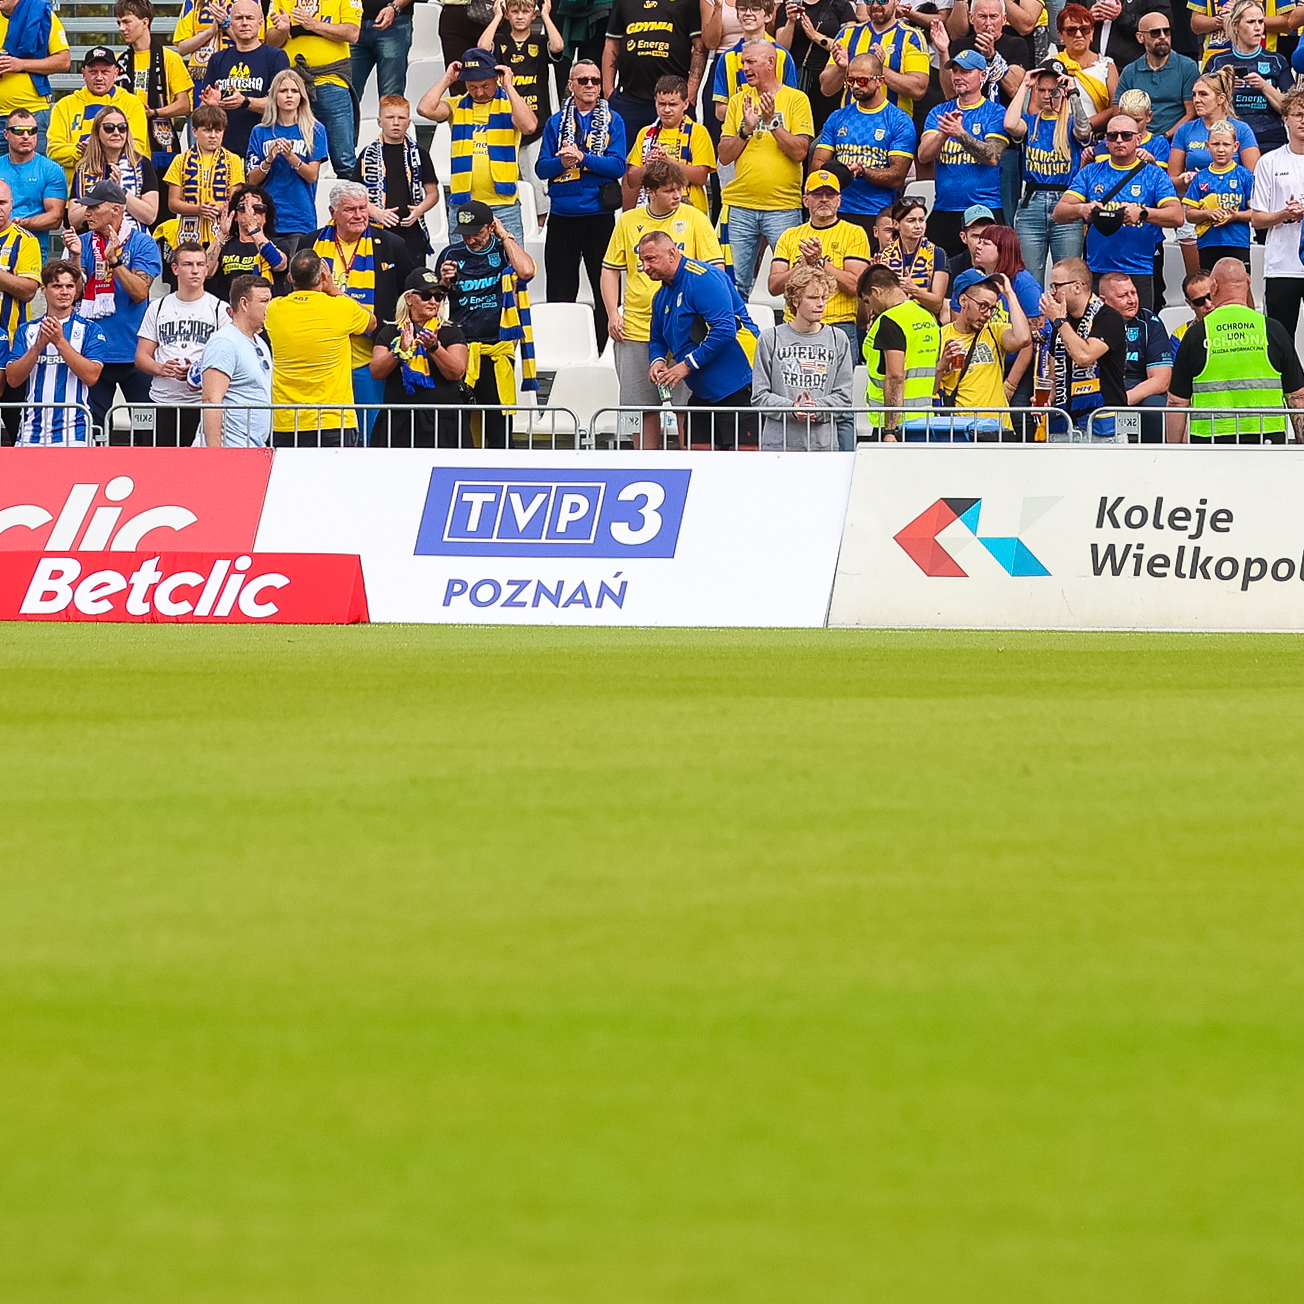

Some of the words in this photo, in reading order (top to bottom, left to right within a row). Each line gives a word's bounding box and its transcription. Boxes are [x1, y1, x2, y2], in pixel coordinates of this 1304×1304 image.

[626, 22, 673, 34] GDYNIA
[637, 40, 669, 51] Energa
[1216, 322, 1255, 332] OCHRONA
[1227, 332, 1245, 340] LION
[777, 346, 835, 361] WIELKA
[783, 371, 828, 387] TRIADA
[460, 492, 591, 534] TVP
[610, 482, 665, 546] 3
[1095, 496, 1234, 534] Koleje
[19, 555, 291, 617] Betclic
[443, 571, 628, 609] POZNAŃ
